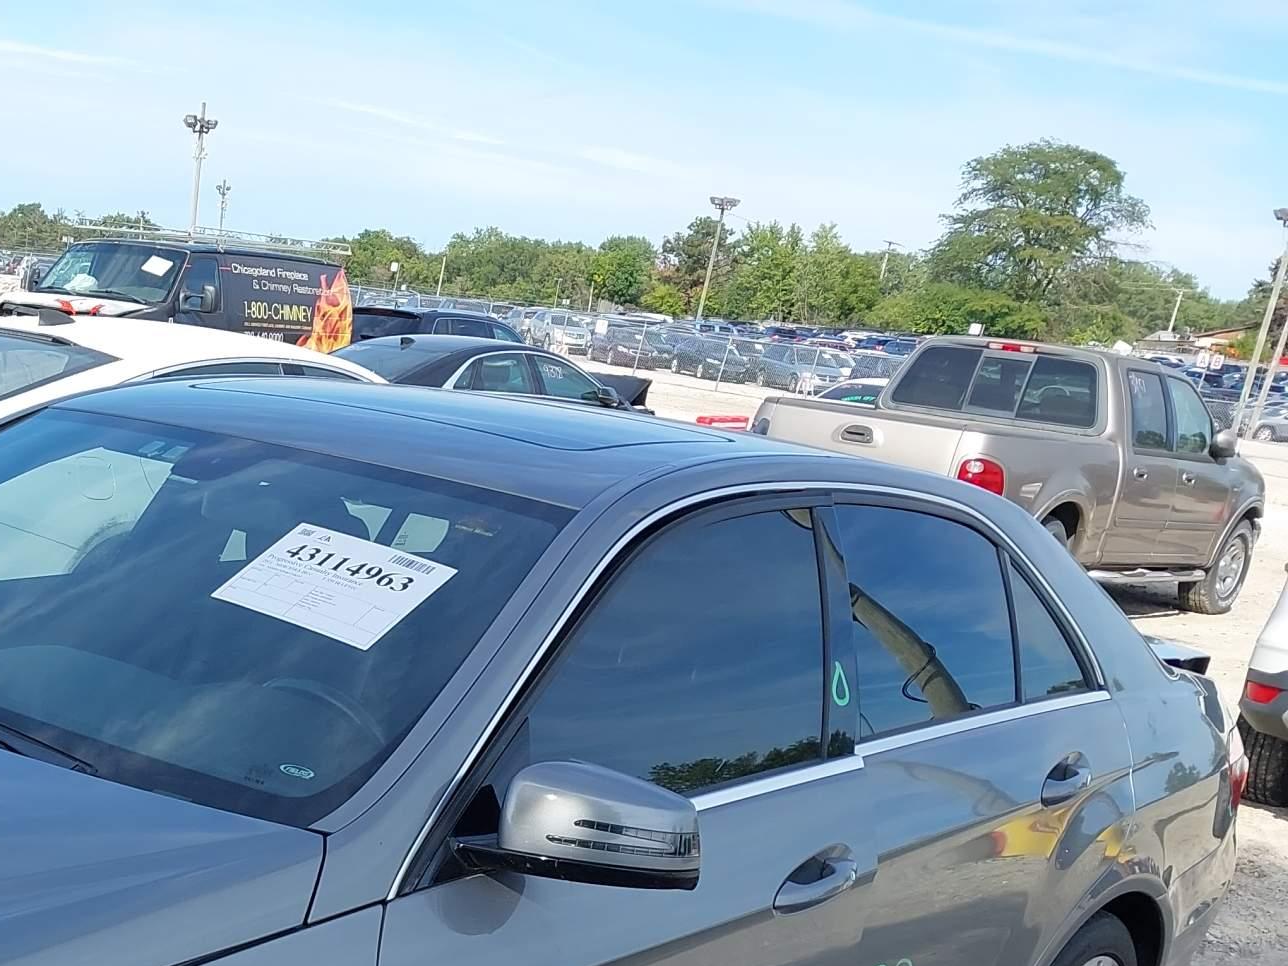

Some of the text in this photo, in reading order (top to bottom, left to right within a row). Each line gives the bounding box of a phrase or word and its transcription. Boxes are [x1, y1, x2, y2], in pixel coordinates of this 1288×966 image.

[231, 263, 309, 281] Chicagoland Fireplace
[252, 280, 260, 290] &
[261, 282, 292, 295] Chimney
[243, 301, 313, 322] 1-800-CHIMNEY
[285, 544, 417, 592] 43114963
